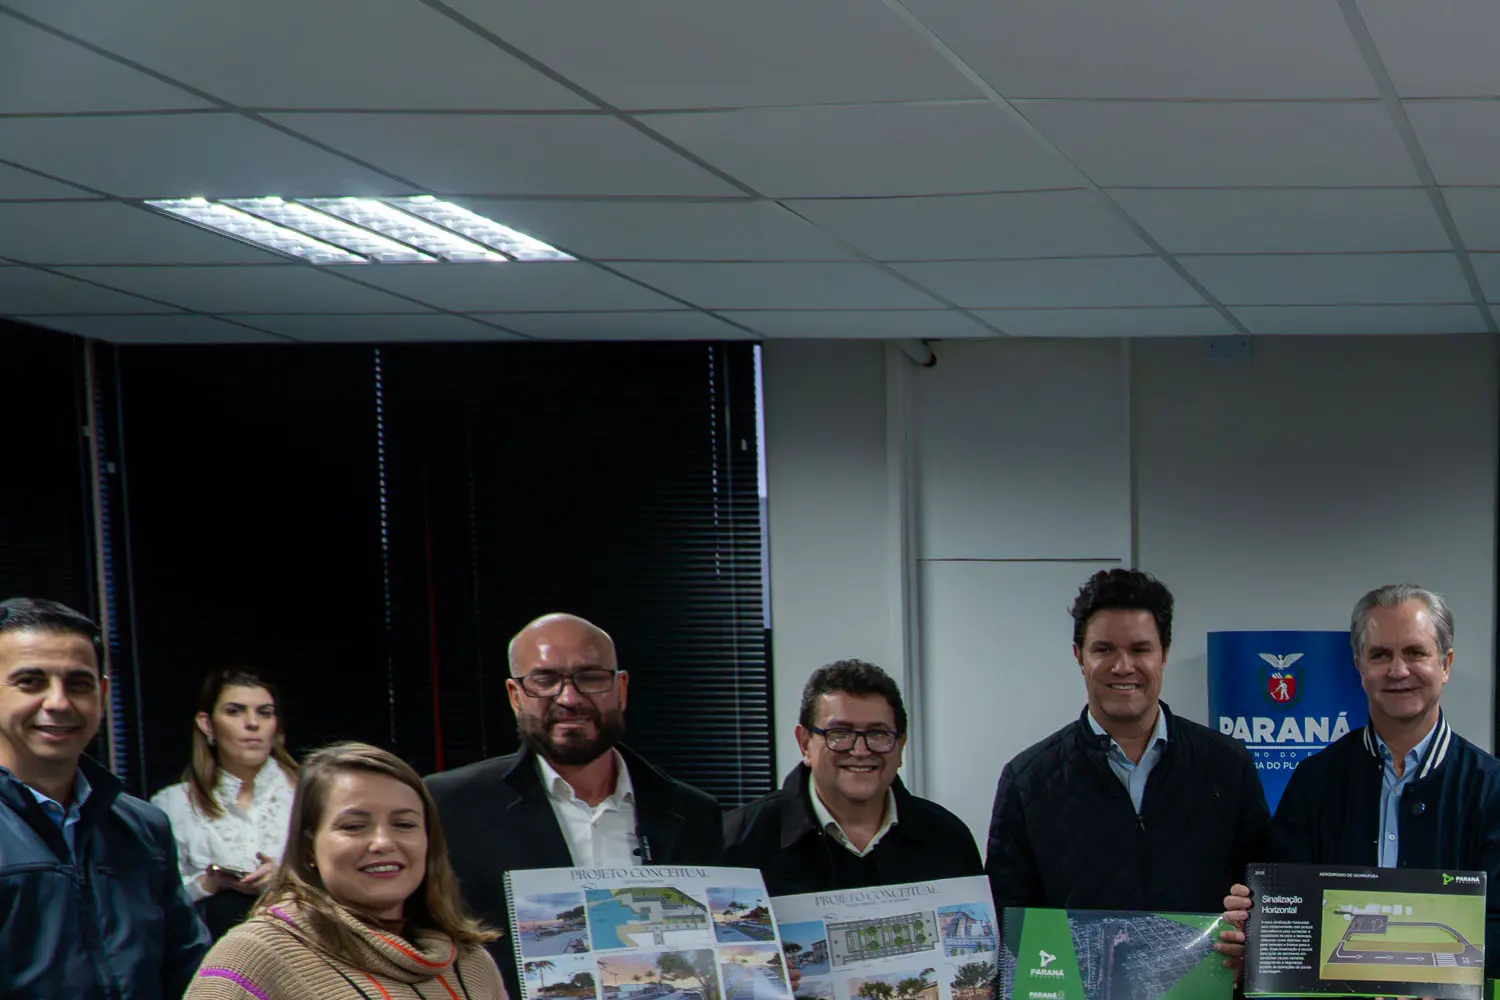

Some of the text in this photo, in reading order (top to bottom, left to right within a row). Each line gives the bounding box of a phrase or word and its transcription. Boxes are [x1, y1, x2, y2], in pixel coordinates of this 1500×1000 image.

[1219, 711, 1351, 743] PARANÁ
[1266, 761, 1281, 769] DO
[570, 868, 627, 881] PROJETO
[1261, 895, 1303, 905] Sinalização
[1261, 905, 1298, 915] Horizontal
[1030, 967, 1065, 976] PARANÁ
